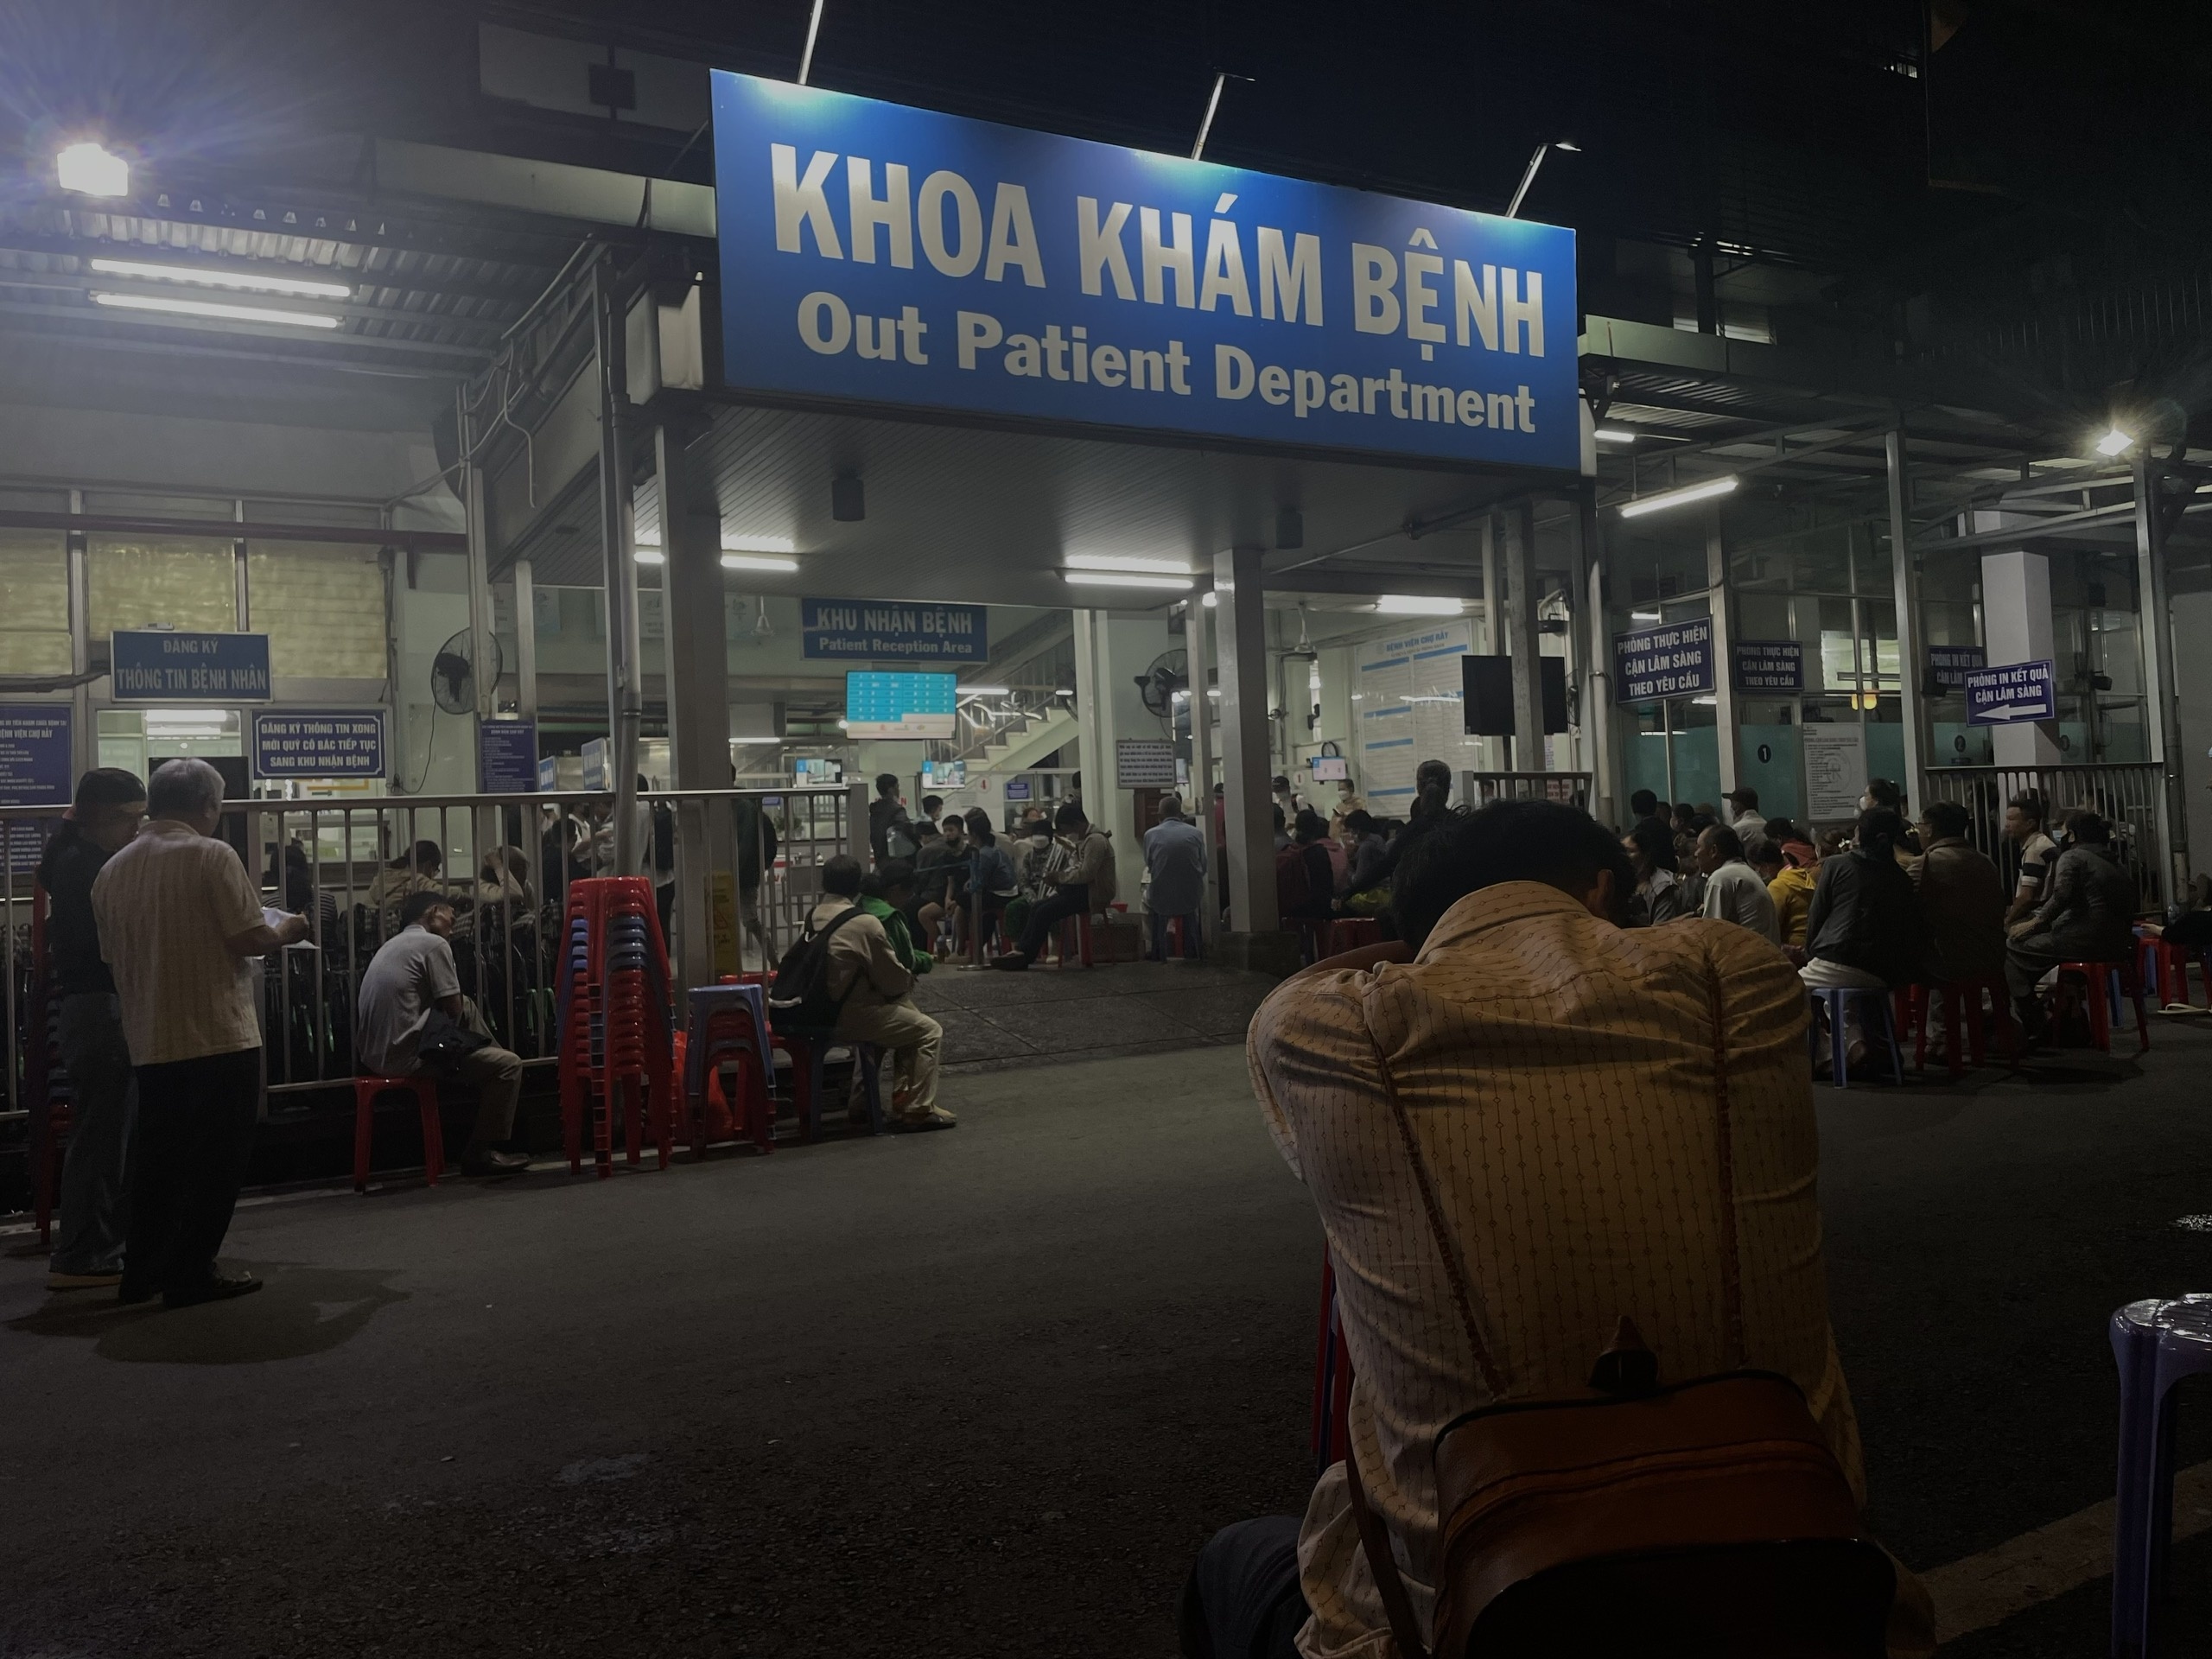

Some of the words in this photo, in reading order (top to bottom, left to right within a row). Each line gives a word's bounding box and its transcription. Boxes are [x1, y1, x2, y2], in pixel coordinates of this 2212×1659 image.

[770, 143, 1046, 289] KHOA
[1077, 192, 1325, 327] KHÁM
[1351, 227, 1546, 361] BỆNH
[796, 291, 929, 365] Out
[957, 309, 1192, 397] Patient
[1216, 344, 1536, 434] Department
[817, 607, 857, 631] KHU
[865, 605, 916, 637] NHẬN
[922, 607, 973, 638] BỆNH
[163, 637, 198, 653] ĐĂNG
[201, 638, 219, 654] KÝ
[819, 637, 868, 652] Patient
[873, 639, 938, 654] Reception
[942, 640, 972, 653] Area
[1618, 636, 1651, 655] PHÒNG
[1653, 631, 1680, 649] THỰC
[1682, 625, 1707, 645] HIỆN
[1625, 658, 1646, 677] CẬN
[1648, 655, 1670, 672] LÂM
[1672, 650, 1702, 668] SÀNG
[117, 662, 162, 690] THÔNG
[165, 668, 188, 690] TIN
[191, 662, 227, 693] BỆNH
[231, 663, 266, 690] NHÂN
[1629, 681, 1654, 696] THEO
[1656, 676, 1676, 693] YÊU
[1678, 670, 1700, 690] CẦU
[1967, 673, 1998, 688] PHÒNG
[1999, 671, 2009, 685] IN
[2011, 667, 2028, 682] KẾT
[2030, 664, 2049, 681] QUẢ
[1975, 689, 1994, 705] CẬN
[1996, 686, 2015, 702] LÂM
[2017, 683, 2043, 698] SÀNG
[289, 721, 300, 734] KÝ
[303, 721, 333, 734] THÔNG
[335, 723, 349, 734] TIN
[353, 723, 376, 734] XONG
[262, 738, 280, 751] MỜI
[283, 738, 300, 752] QUÝ
[302, 738, 315, 751] CÔ
[317, 738, 336, 751] BÁC
[338, 736, 357, 750] TIẾP
[359, 740, 377, 753] TỤC
[1763, 747, 1767, 760] 1
[270, 755, 295, 767] SANG
[297, 756, 316, 766] KHU
[318, 753, 344, 768] NHẬN
[346, 753, 370, 768] BỆNH
